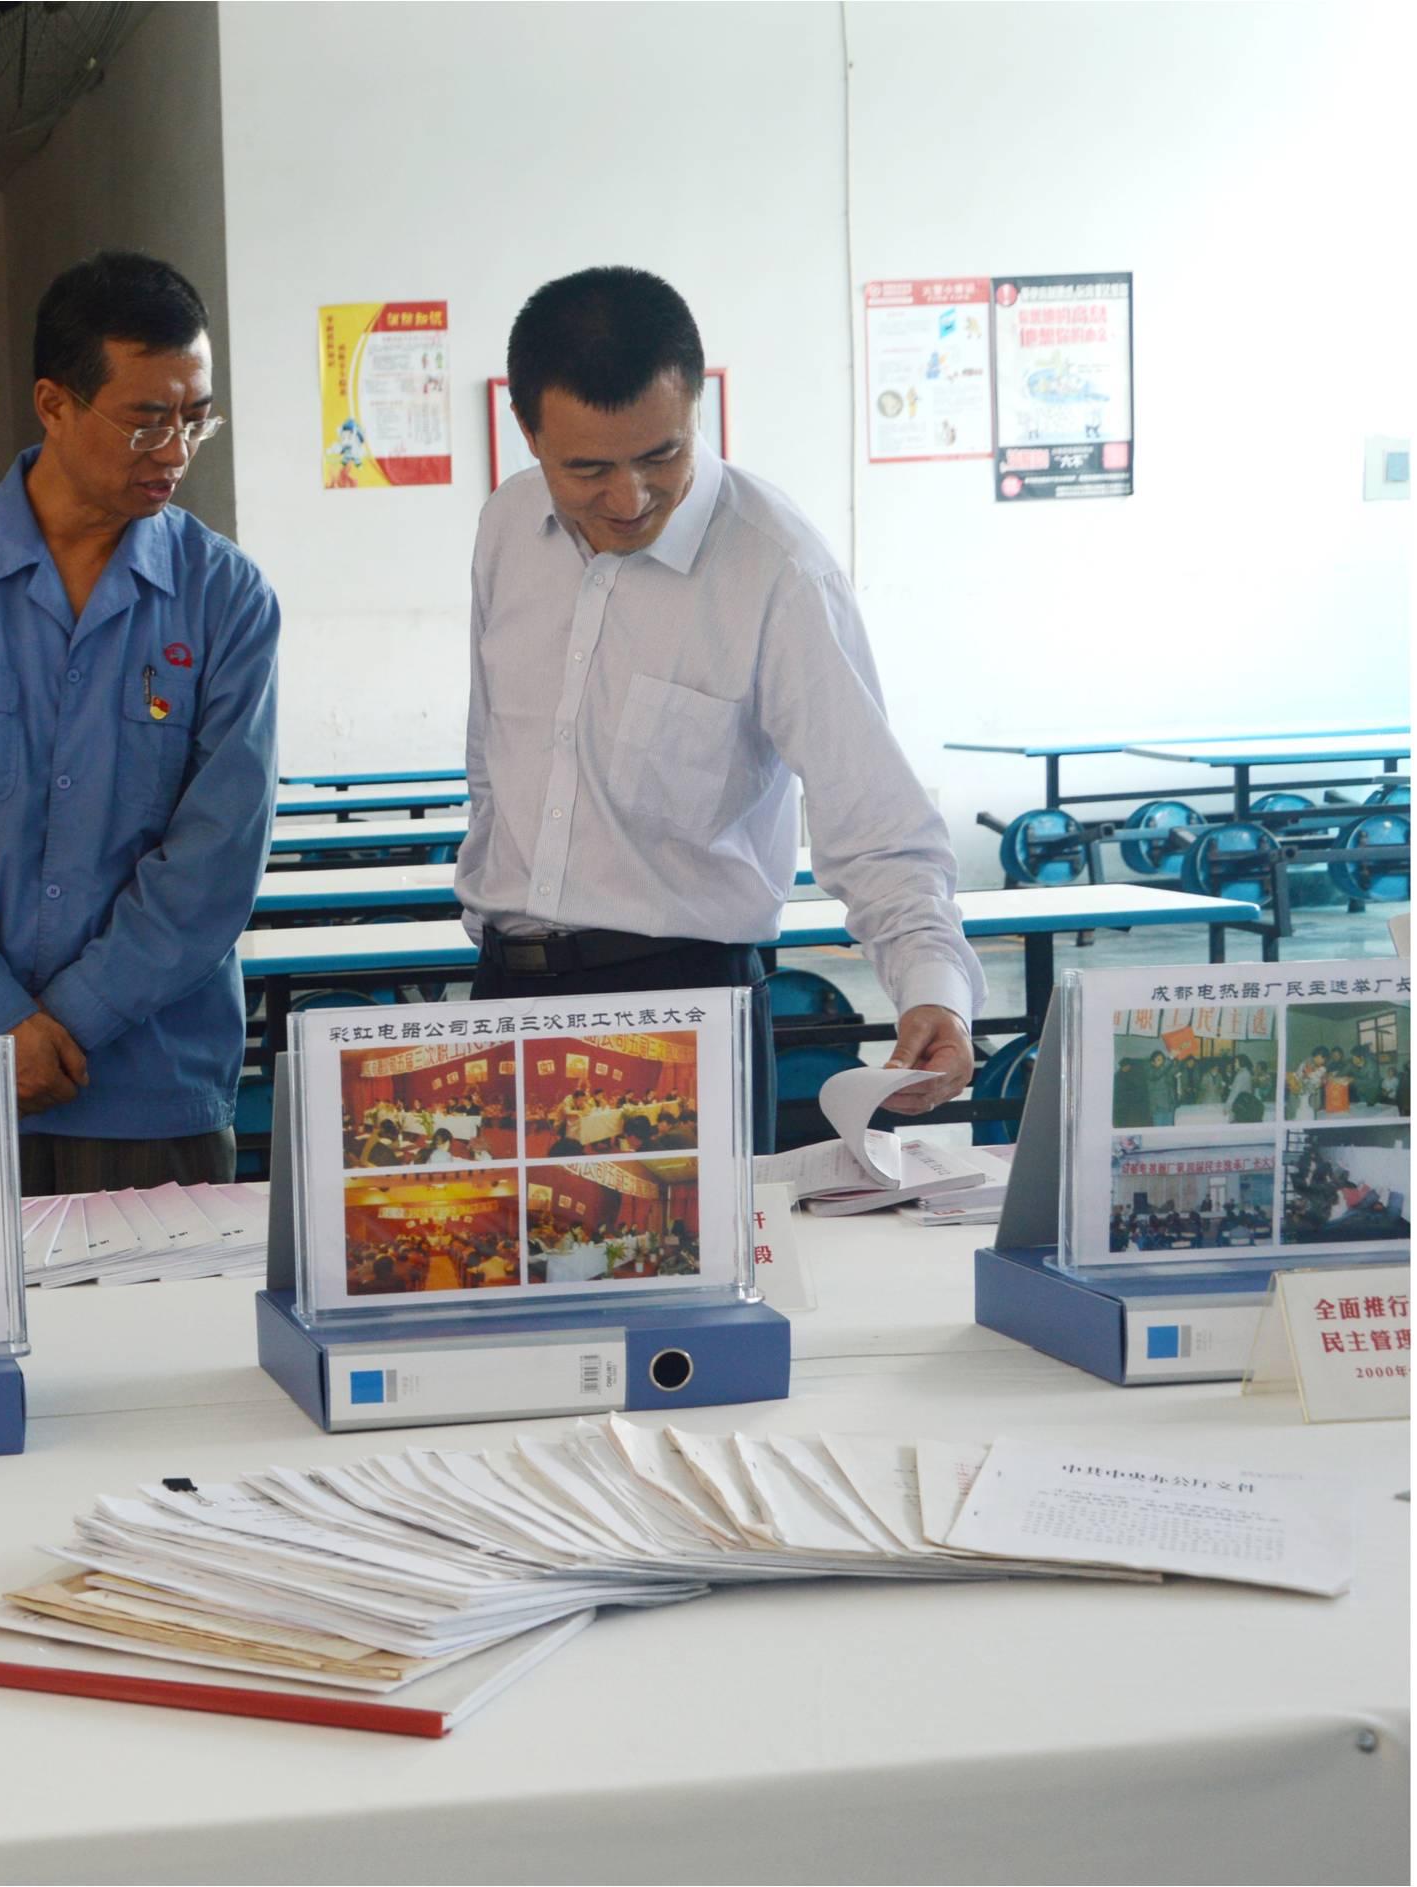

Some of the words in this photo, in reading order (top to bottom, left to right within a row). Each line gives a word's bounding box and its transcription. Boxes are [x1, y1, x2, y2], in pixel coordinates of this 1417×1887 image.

[1151, 976, 1410, 1002] 成都电热器厂民主选举厂长
[328, 1006, 707, 1043] 彩虹电器公司五届三次职工代表大会
[754, 1245, 773, 1264] 段
[1314, 1295, 1410, 1320] 全面推行
[1321, 1329, 1410, 1353] 民主管理
[1062, 1463, 1254, 1493] 中共中央办公厅文件
